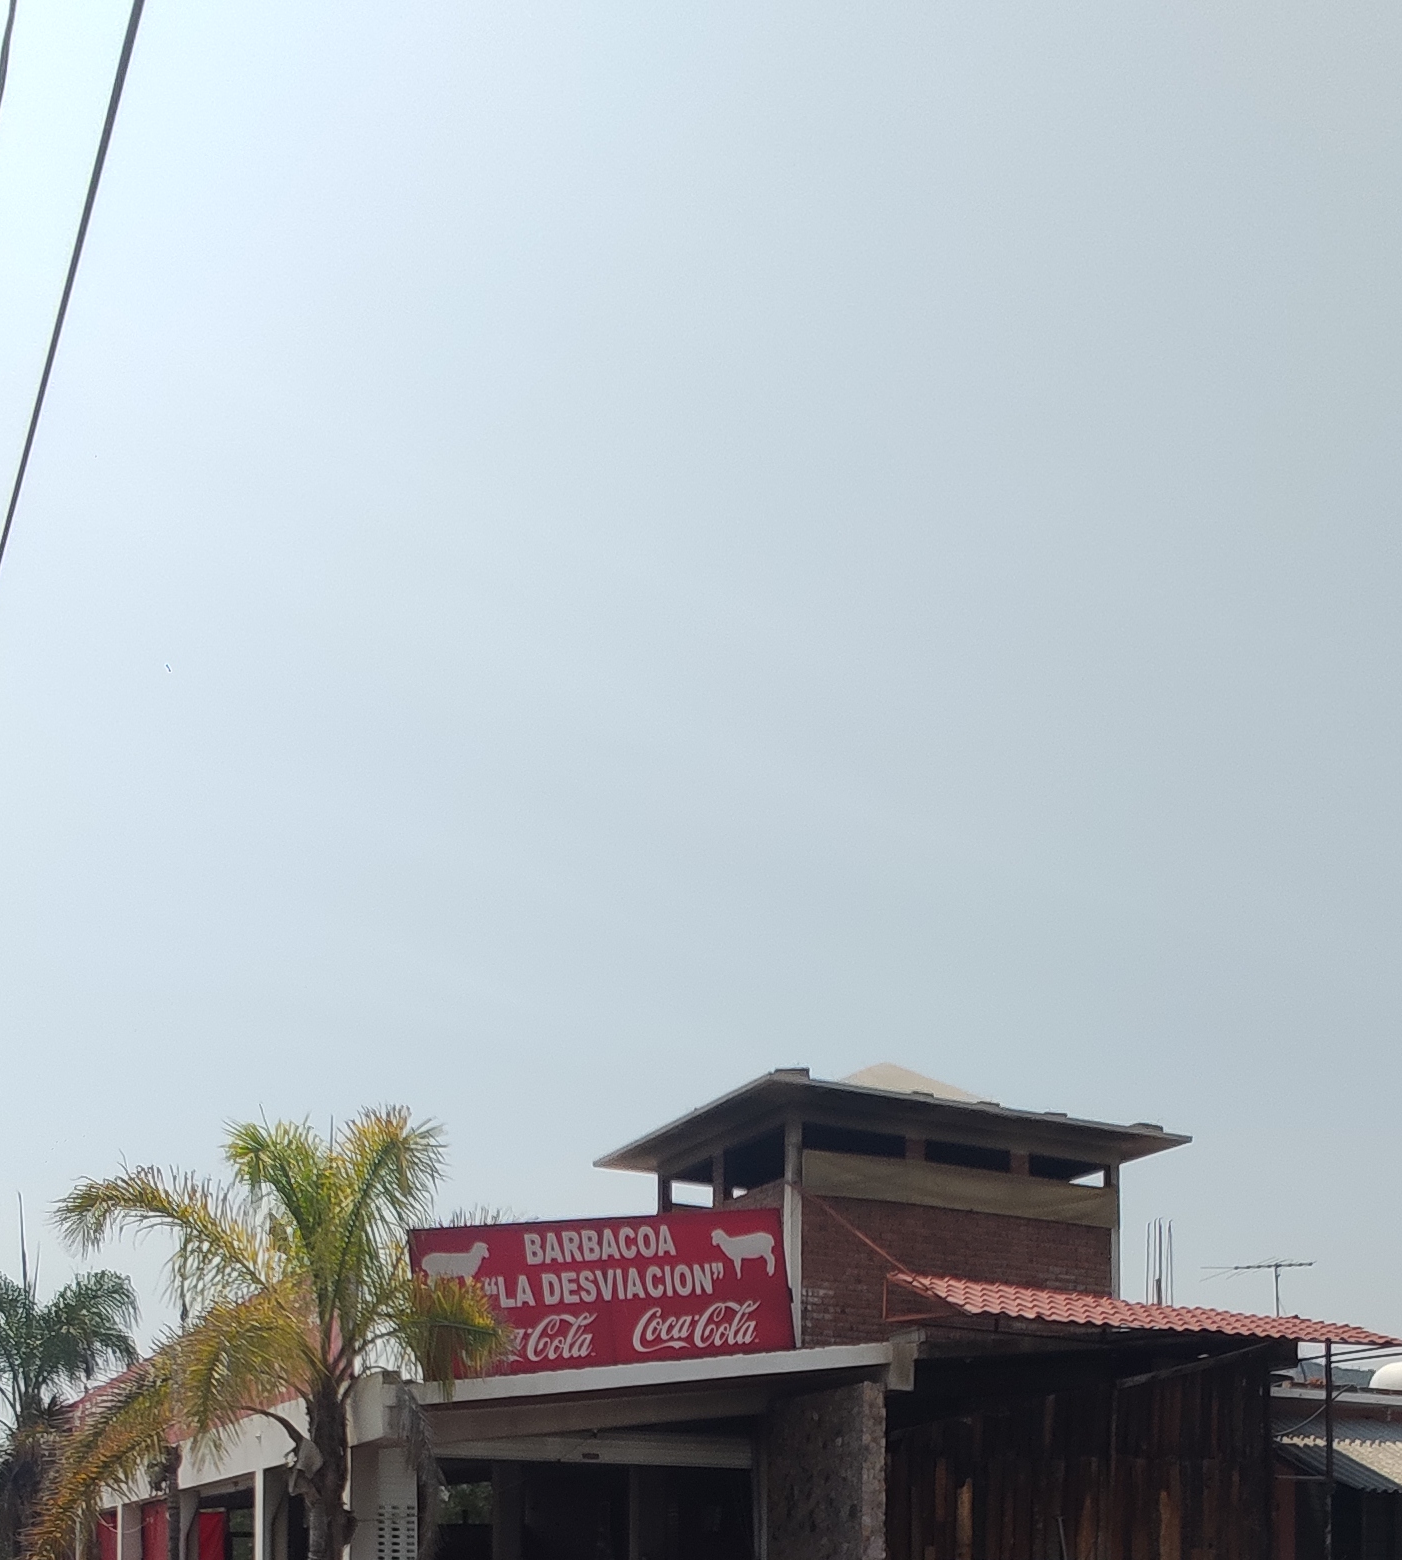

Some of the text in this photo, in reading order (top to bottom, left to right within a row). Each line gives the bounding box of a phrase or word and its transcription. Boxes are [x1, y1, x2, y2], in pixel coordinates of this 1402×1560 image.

[523, 1225, 677, 1266] BARBACOA
[483, 1262, 725, 1308] “LA DESVIACION”
[632, 1300, 761, 1353] Coca-Cola
